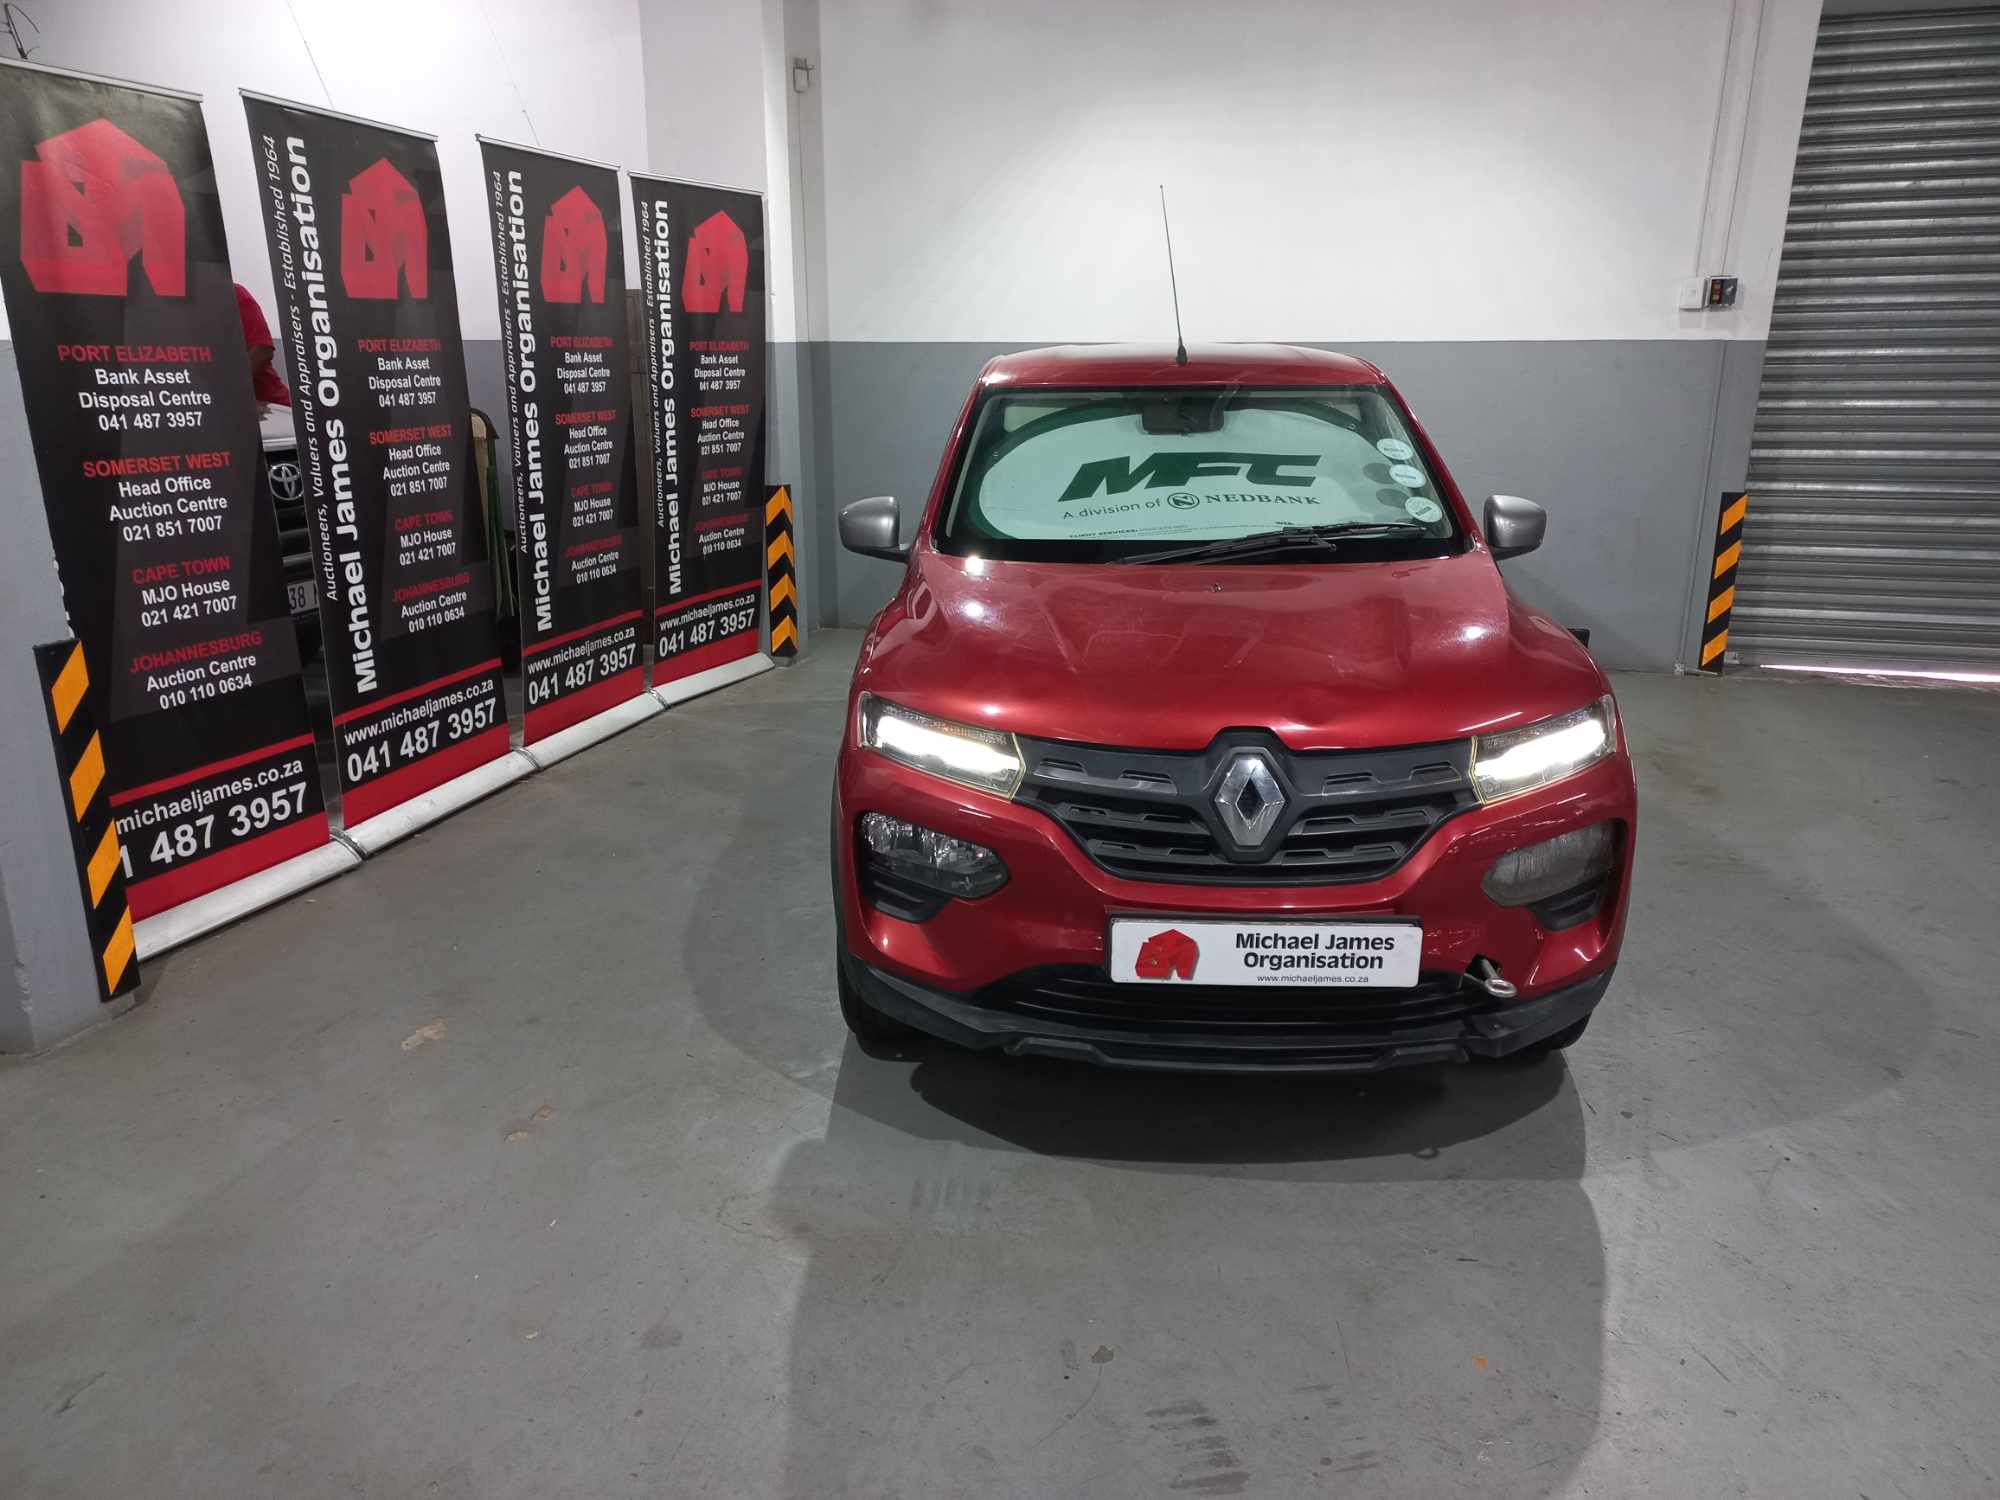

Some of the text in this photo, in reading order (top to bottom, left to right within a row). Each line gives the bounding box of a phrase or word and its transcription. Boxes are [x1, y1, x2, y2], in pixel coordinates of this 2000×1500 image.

[58, 346, 212, 362] PORT ELIZABETH
[358, 339, 386, 352] PORT
[648, 318, 658, 382] Appraisers
[263, 135, 338, 601] Auctioneers, Valuers and Appraisers Established 1964
[378, 357, 430, 371] Bank Asset
[493, 171, 528, 553] Auctioneers, Valuers and Appraisers Established 1964
[565, 352, 602, 363] Bank Asset
[701, 354, 738, 365] Bank Asset
[95, 368, 191, 386] Bank Asset
[368, 374, 441, 392] Disposal Centre
[557, 367, 610, 380] Disposal Centre
[694, 367, 722, 379] Disposal
[564, 383, 575, 394] 041
[710, 380, 741, 391] 487 3957
[79, 390, 211, 411] Disposal Centre
[379, 391, 436, 408] 041 487 3957
[508, 170, 552, 632] Michael James Organisation
[654, 200, 682, 594] Michael James Organisation
[98, 411, 203, 431] 041 487 3957
[286, 136, 378, 694] Michael James Organisation
[719, 418, 739, 428] Office
[369, 424, 452, 445] SOMERSET WEST
[569, 425, 607, 439] Head Office
[388, 443, 442, 462] Head Office
[564, 440, 613, 455] Auction Centre
[711, 442, 741, 454] 851 7007
[83, 452, 232, 478] SOMERSET WEST
[383, 459, 450, 481] Auction Centre
[569, 457, 580, 469] 021
[582, 455, 593, 467] 851
[119, 476, 212, 498] Head Office
[390, 476, 448, 497] 021 851 7007
[718, 481, 740, 490] House
[1058, 452, 1322, 502] MFC
[109, 496, 228, 521] Auction Centre
[574, 498, 611, 512] MJO House
[712, 493, 724, 503] 421
[1063, 494, 1321, 520] A division of NEDBANK
[123, 515, 223, 542] 021 851 7007
[573, 515, 584, 527] 021
[585, 513, 596, 524] 421
[400, 528, 453, 549] MJO House
[399, 542, 457, 567] 021 421 7007
[571, 552, 619, 571] Auction Centre
[131, 556, 232, 585] CAPE TOWN
[589, 568, 600, 580] 110
[142, 578, 231, 606] MJO House
[141, 595, 239, 628] 021 421 7007
[401, 590, 467, 619] Auction Centre
[660, 593, 755, 631] www.michaeljames.co.za
[408, 607, 465, 633] 010 110 0634
[660, 608, 755, 657] 041 487 3957
[129, 630, 262, 673] JOHANNESBURG
[527, 627, 635, 674] www.michaeljames.co.za
[146, 655, 257, 692] Auction Centre
[528, 643, 636, 704] 041 487 3957
[159, 673, 253, 710] 010 110 0634
[345, 678, 494, 747] www.michaeljames.co.za
[347, 697, 497, 782] 041 487 3957
[115, 759, 303, 835] michaeljames.co.za
[150, 815, 215, 865] 487
[228, 781, 308, 838] 3957
[1235, 933, 1395, 951] Michael James
[1243, 952, 1384, 970] Organisation
[1257, 974, 1369, 983] www.michaeljames.co.za
